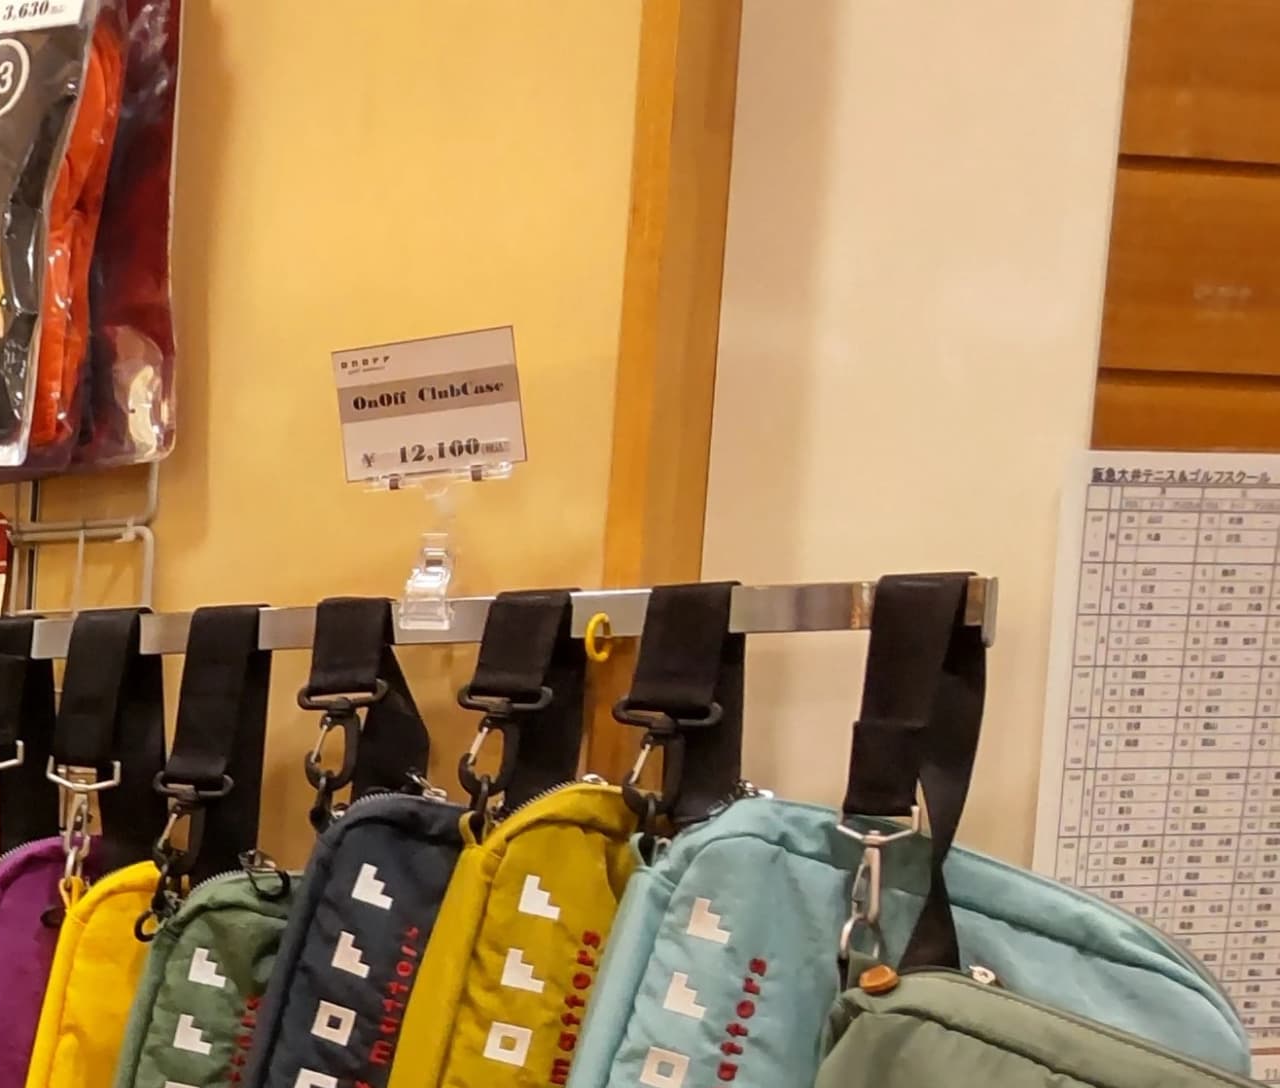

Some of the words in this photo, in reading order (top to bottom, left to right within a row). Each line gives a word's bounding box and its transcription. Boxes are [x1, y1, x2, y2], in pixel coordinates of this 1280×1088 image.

[352, 390, 408, 412] OnOff
[417, 380, 505, 402] ClubCase
[398, 438, 481, 465] 12,100
